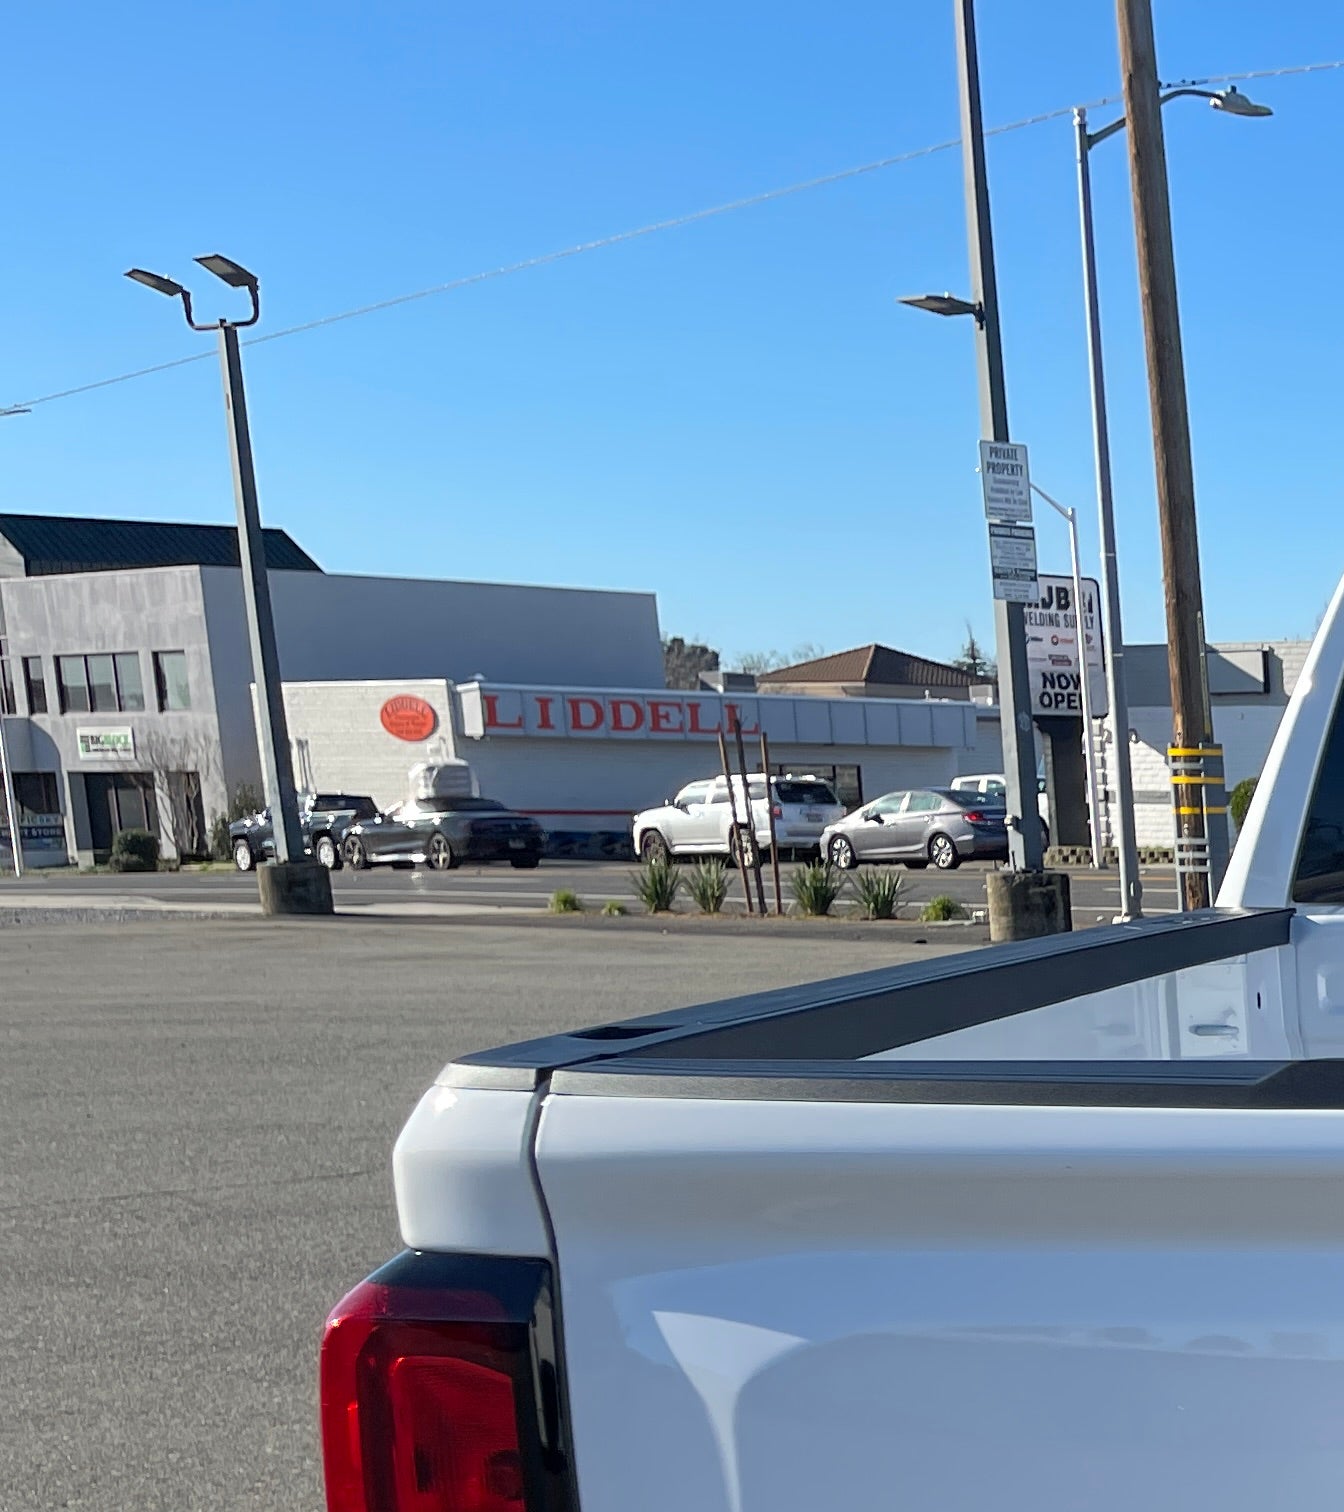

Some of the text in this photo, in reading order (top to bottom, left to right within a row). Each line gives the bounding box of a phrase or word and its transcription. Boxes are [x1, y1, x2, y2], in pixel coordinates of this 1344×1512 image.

[989, 446, 1018, 460] PRIVATE
[987, 462, 1023, 476] PROPERTY
[483, 695, 758, 735] LIDDELL
